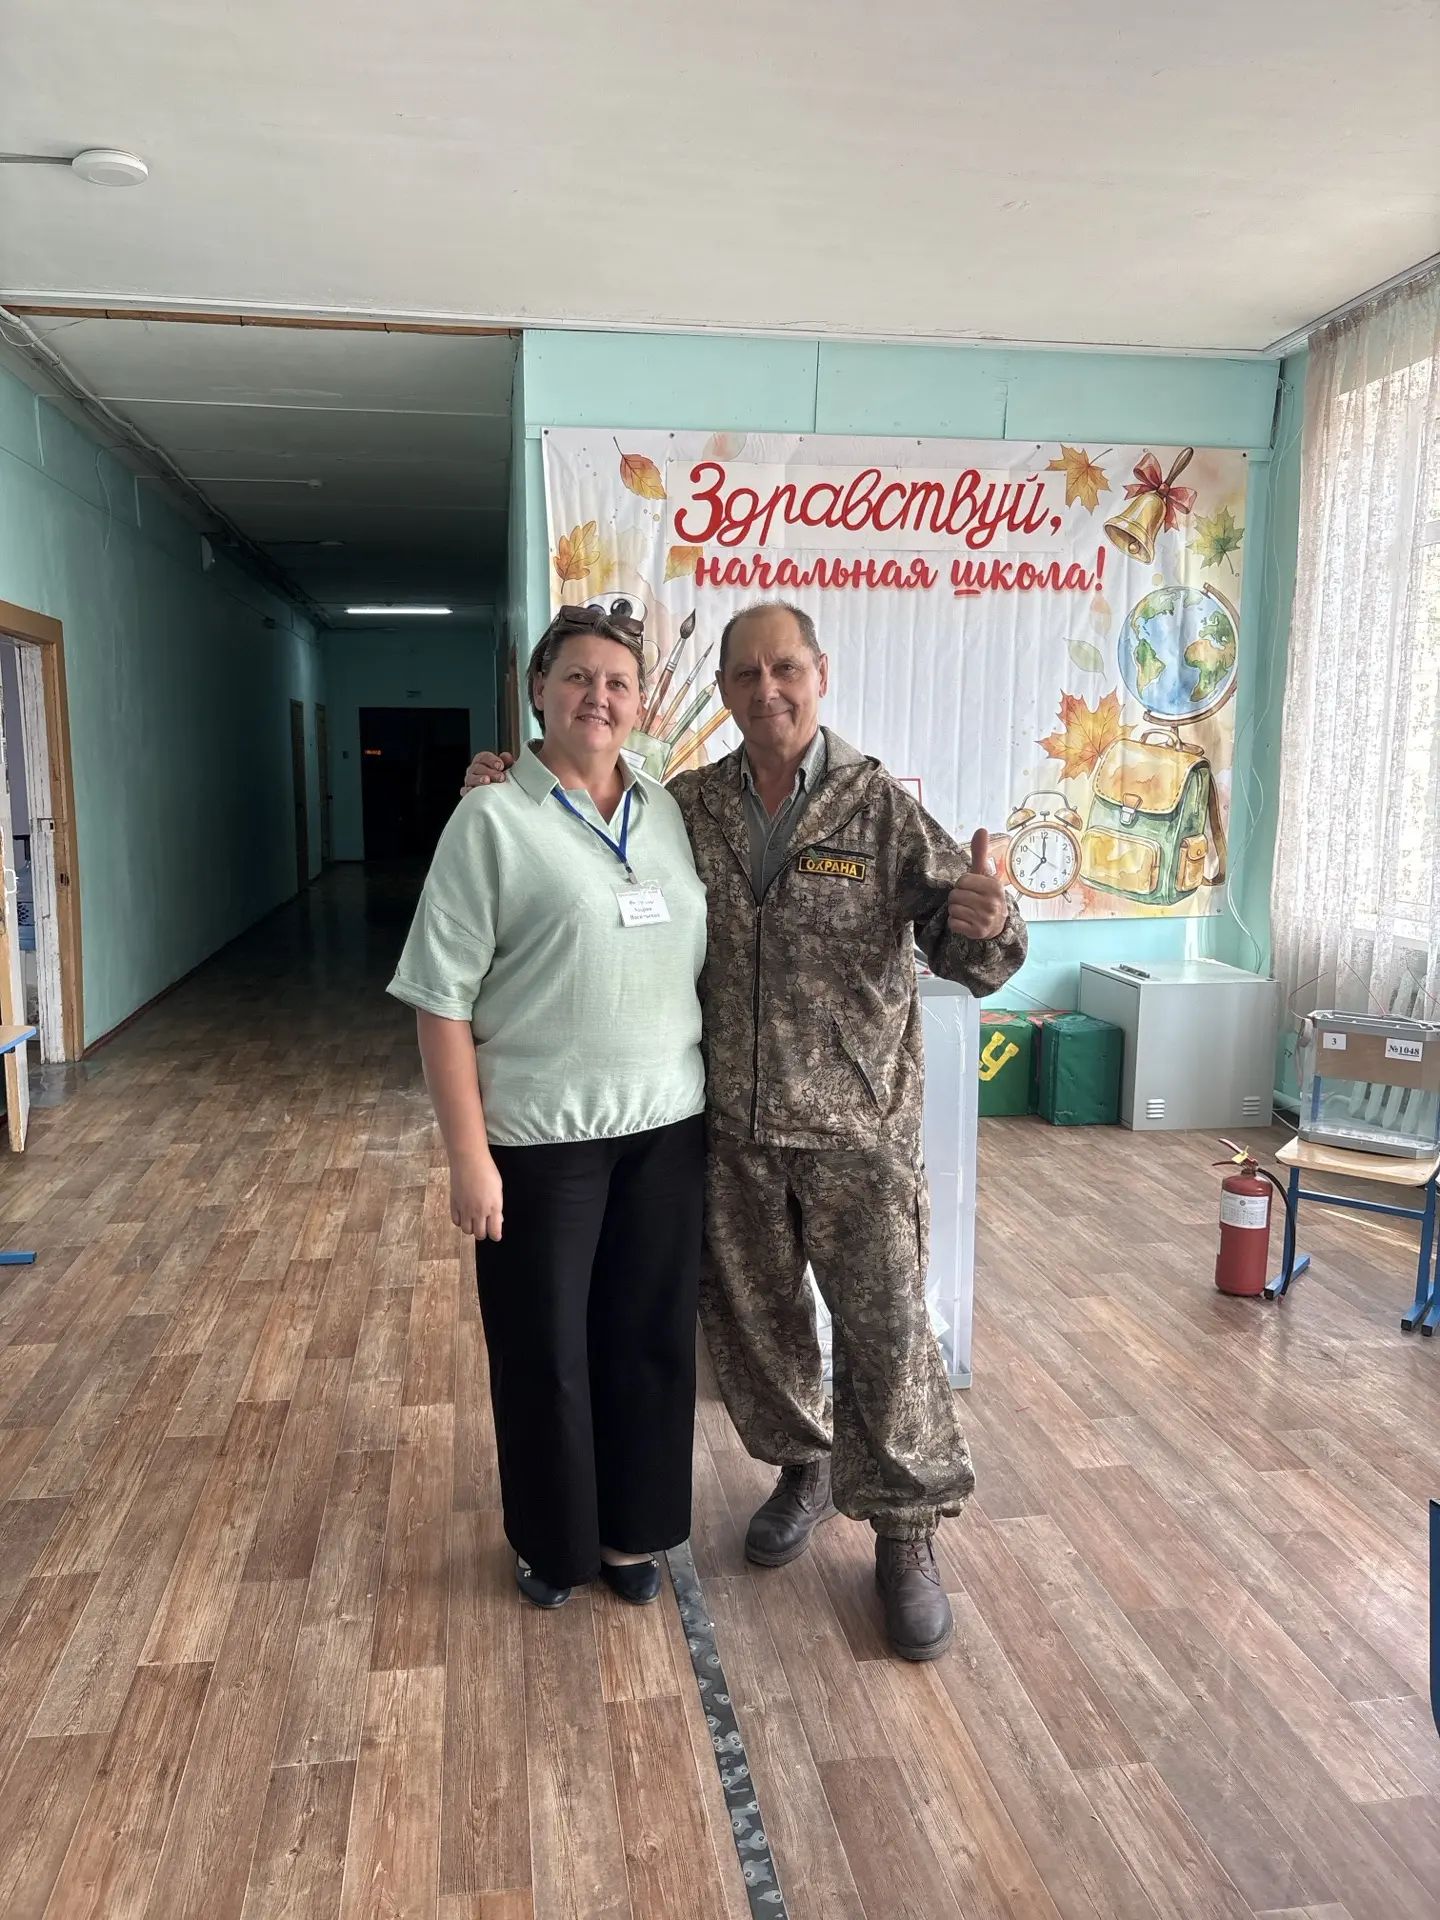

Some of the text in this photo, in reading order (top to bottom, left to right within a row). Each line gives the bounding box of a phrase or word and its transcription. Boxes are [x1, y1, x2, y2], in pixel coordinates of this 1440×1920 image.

[674, 461, 1062, 550] Здравствуй,
[695, 545, 1106, 596] начальная школа!
[1041, 831, 1049, 839] 12
[1063, 843, 1068, 851] 2
[1016, 857, 1021, 865] 9
[1066, 856, 1071, 864] 3
[806, 859, 857, 876] ОХРАНА
[1028, 878, 1033, 886] 7
[1040, 881, 1046, 889] 6
[1053, 877, 1058, 885] 5
[1331, 1037, 1337, 1046] 3
[1387, 1044, 1420, 1058] №1048
